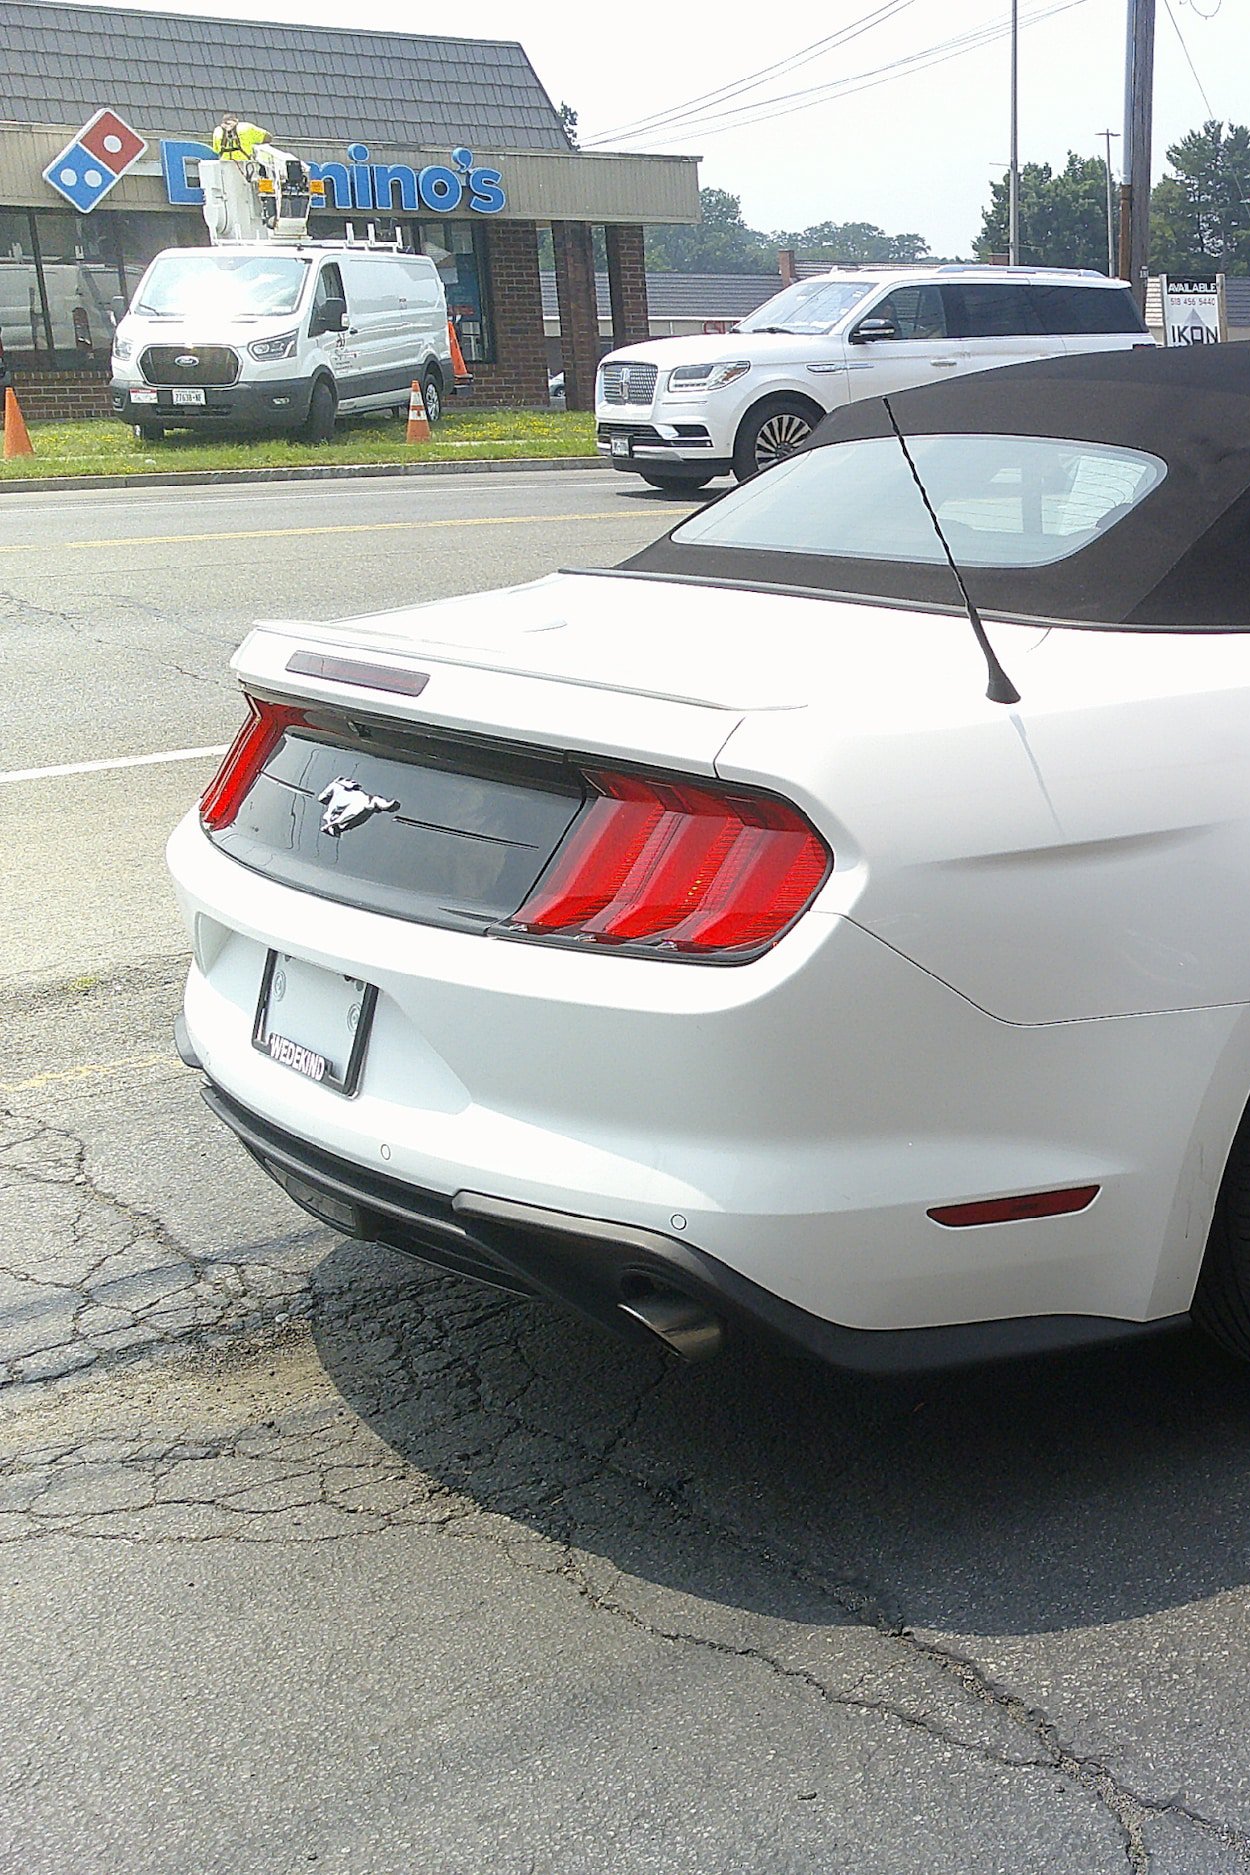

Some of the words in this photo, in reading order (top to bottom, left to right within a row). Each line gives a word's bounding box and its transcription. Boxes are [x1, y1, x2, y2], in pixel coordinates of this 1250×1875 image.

[160, 139, 506, 214] Dmino's
[1168, 282, 1217, 293] AVAILABLE
[1171, 325, 1218, 343] IKON
[270, 1034, 326, 1081] WEDEKIND
